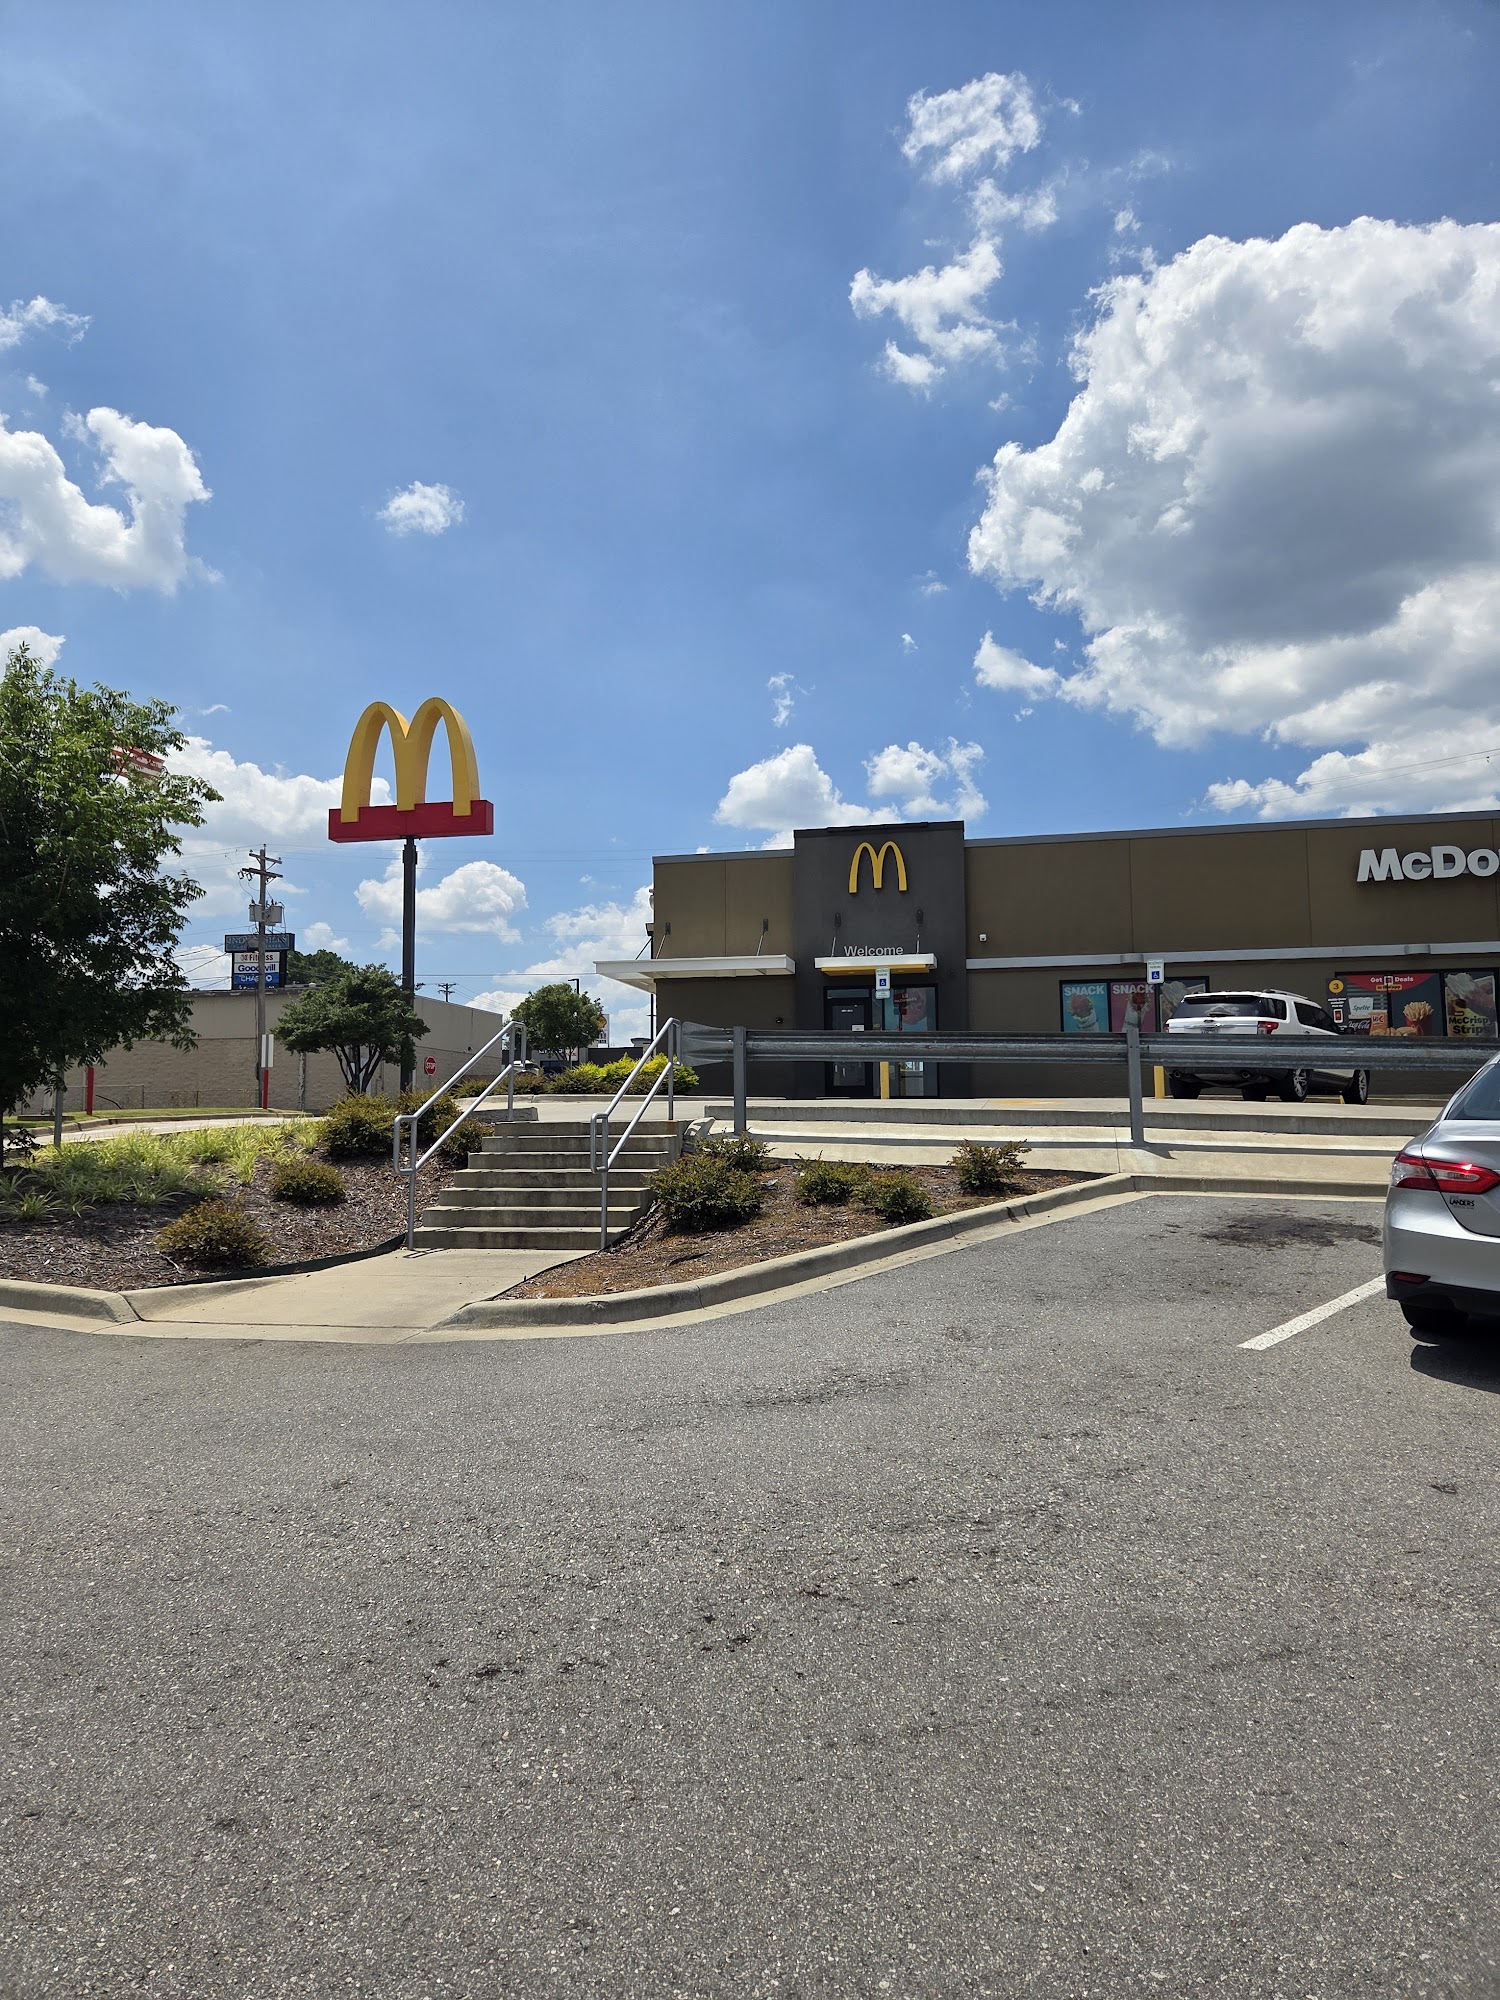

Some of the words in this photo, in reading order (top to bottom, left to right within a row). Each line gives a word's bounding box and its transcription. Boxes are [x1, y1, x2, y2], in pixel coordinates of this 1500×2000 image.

[1357, 845, 1500, 882] McDo
[844, 945, 903, 957] Welcome
[1064, 985, 1105, 996] SNACK
[1112, 984, 1155, 995] SNACK
[1352, 1003, 1371, 1011] Sprite
[1449, 1199, 1475, 1207] LANDERS
